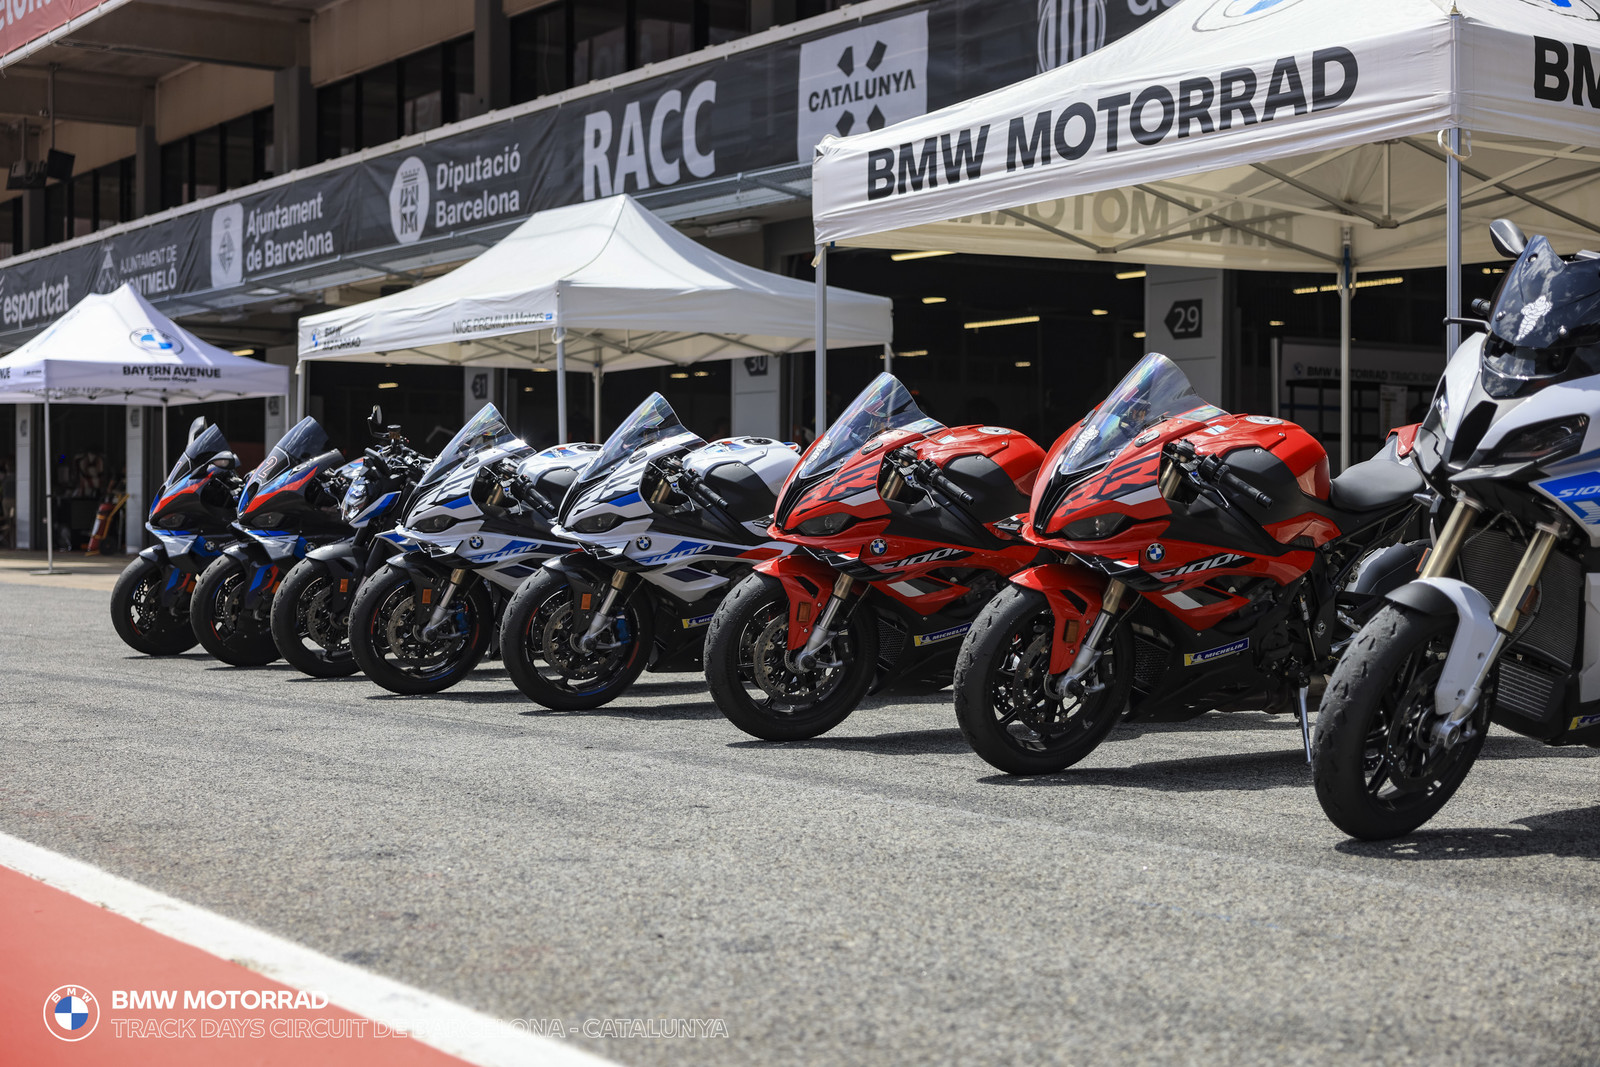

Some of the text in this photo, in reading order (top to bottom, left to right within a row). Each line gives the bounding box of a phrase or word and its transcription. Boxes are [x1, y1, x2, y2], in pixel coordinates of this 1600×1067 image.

[808, 69, 916, 112] CATALUNYA
[867, 46, 1359, 201] BMW MOTORRAD
[583, 80, 717, 201] RACC
[436, 144, 521, 193] Diputació
[246, 192, 323, 243] Ajuntament
[435, 190, 520, 228] Barcelona
[120, 244, 177, 273] AJUNTAMENT DE
[247, 231, 334, 272] de Barcelona
[120, 262, 177, 295] NTMELÓ
[3, 275, 70, 330] esportcat
[1174, 307, 1199, 333] 29
[122, 365, 221, 378] BAYERN AVENUE
[750, 356, 767, 371] 30
[1334, 368, 1388, 380] MTORRAD
[1557, 486, 1600, 498] S10
[932, 626, 969, 640] MICHELIN
[1204, 643, 1244, 659] MICHELIN
